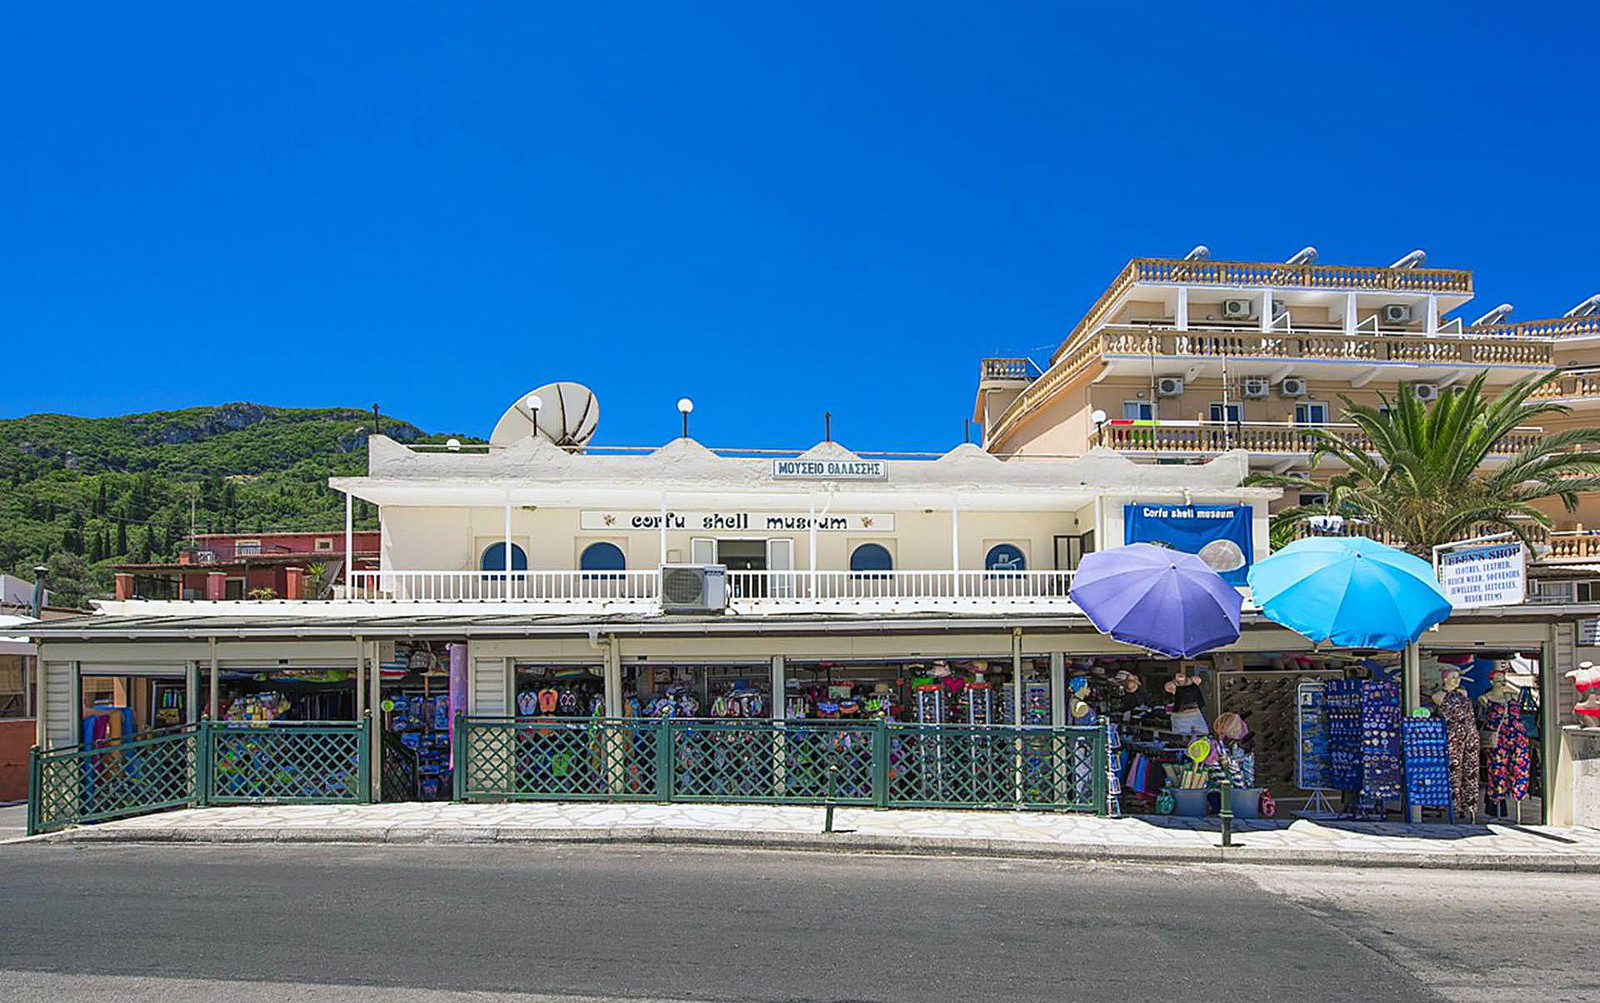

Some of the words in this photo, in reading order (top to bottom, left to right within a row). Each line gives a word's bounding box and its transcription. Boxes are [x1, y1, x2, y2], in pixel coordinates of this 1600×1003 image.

[779, 462, 824, 474] ΜΟΥΣΕΙΟ
[828, 463, 880, 475] ΘΑΛΑΣΣΗΣ
[1143, 507, 1168, 517] Corfu
[1171, 508, 1194, 518] shell
[1197, 510, 1234, 518] museum
[632, 512, 685, 528] corfu
[703, 513, 748, 529] shell
[767, 516, 847, 529] museum
[1489, 547, 1520, 560] SHOP
